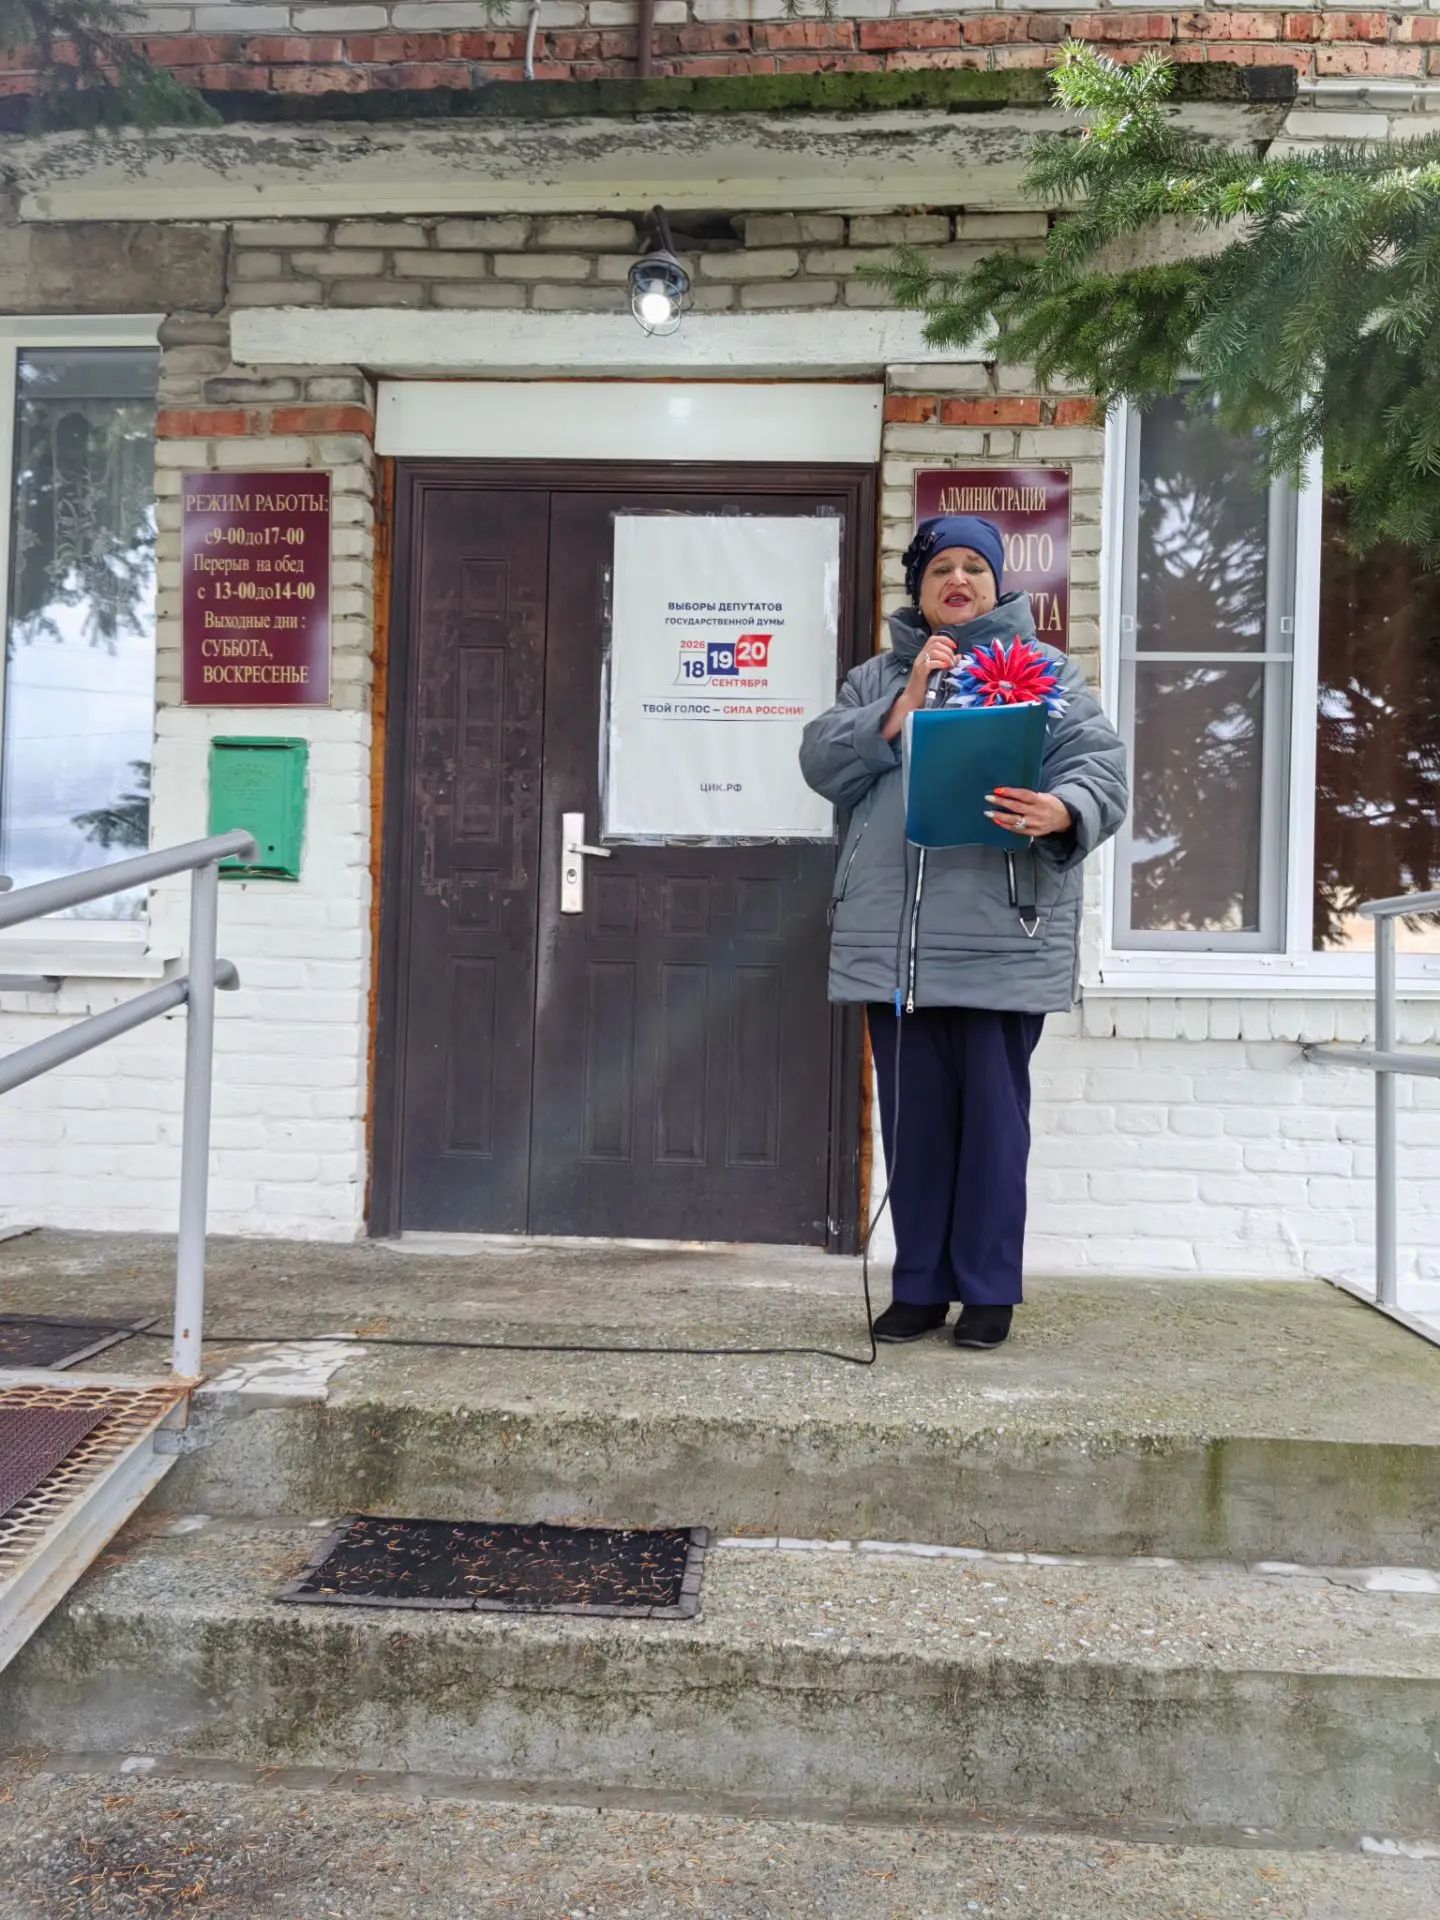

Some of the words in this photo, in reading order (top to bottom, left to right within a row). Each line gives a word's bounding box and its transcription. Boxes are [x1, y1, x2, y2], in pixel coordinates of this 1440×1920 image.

[185, 494, 250, 512] РЕЖИМ
[254, 494, 329, 512] РАБОТЫ:
[938, 487, 1046, 514] АДМИНИСТРАЦИЯ
[193, 553, 250, 576] Перерыв
[256, 560, 271, 573] на
[274, 554, 304, 574] обед
[197, 587, 206, 600] с
[668, 602, 716, 611] ВЫБОРЫ
[718, 602, 782, 612] ДЕПУТАТОВ
[205, 611, 271, 629] Выходные
[665, 617, 755, 626] ГОСУДАРСТВЕННОЙ
[756, 617, 785, 626] ДУМЫ
[202, 639, 273, 660] СУББОТА,
[680, 640, 705, 649] 2026
[682, 660, 705, 678] 18
[710, 650, 733, 669] 19
[737, 641, 766, 660] 20
[203, 665, 309, 684] ВОСКРЕСЕНЬЕ
[711, 678, 768, 687] СЕНТЯБРЯ
[642, 703, 672, 713] ТВОЙ
[674, 704, 711, 714] ГОЛОС
[723, 705, 753, 715] СИЛА
[755, 705, 804, 715] РОССИИ!
[700, 783, 742, 794] ЦИК.РФ
